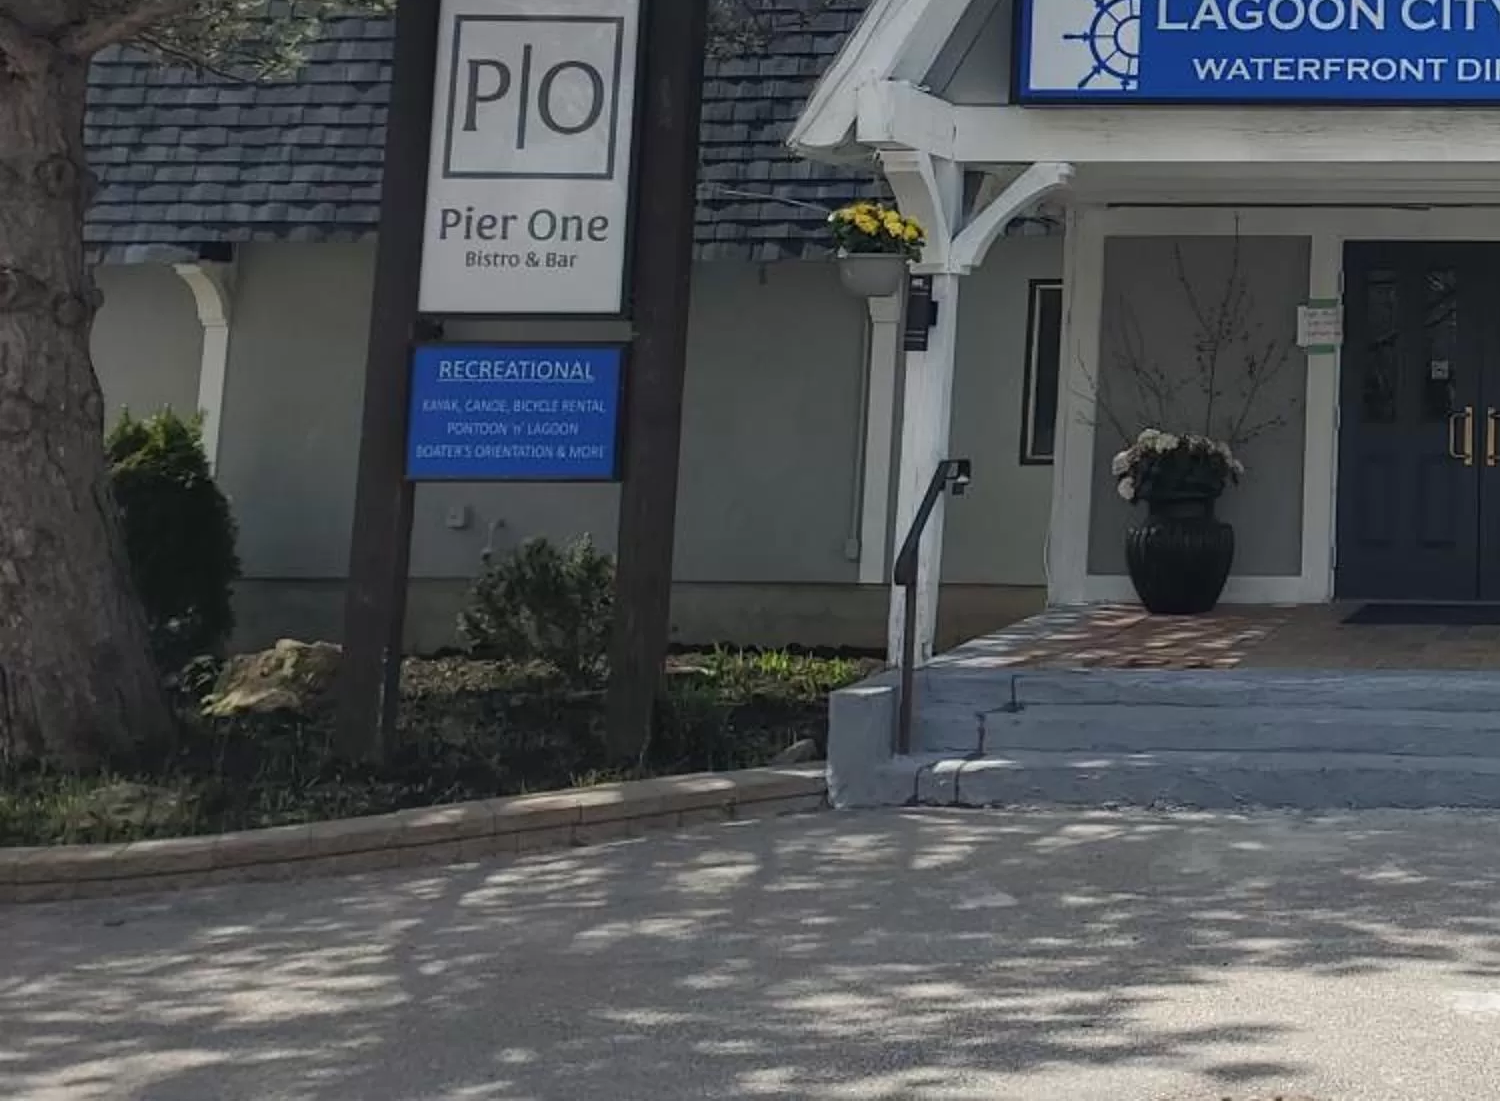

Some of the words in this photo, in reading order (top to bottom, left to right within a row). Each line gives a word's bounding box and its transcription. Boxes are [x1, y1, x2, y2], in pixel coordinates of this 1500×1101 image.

[1193, 58, 1448, 82] WATERFRONT
[439, 207, 517, 240] Pier
[527, 209, 609, 241] One
[465, 251, 520, 268] Bistro
[525, 252, 540, 267] &
[545, 252, 578, 268] Bar
[438, 360, 595, 380] RECREATIONAL
[513, 399, 558, 412] BICYCLE
[561, 399, 606, 413] RENTAL
[447, 422, 508, 436] PONTOON
[528, 422, 579, 436] LAGOON
